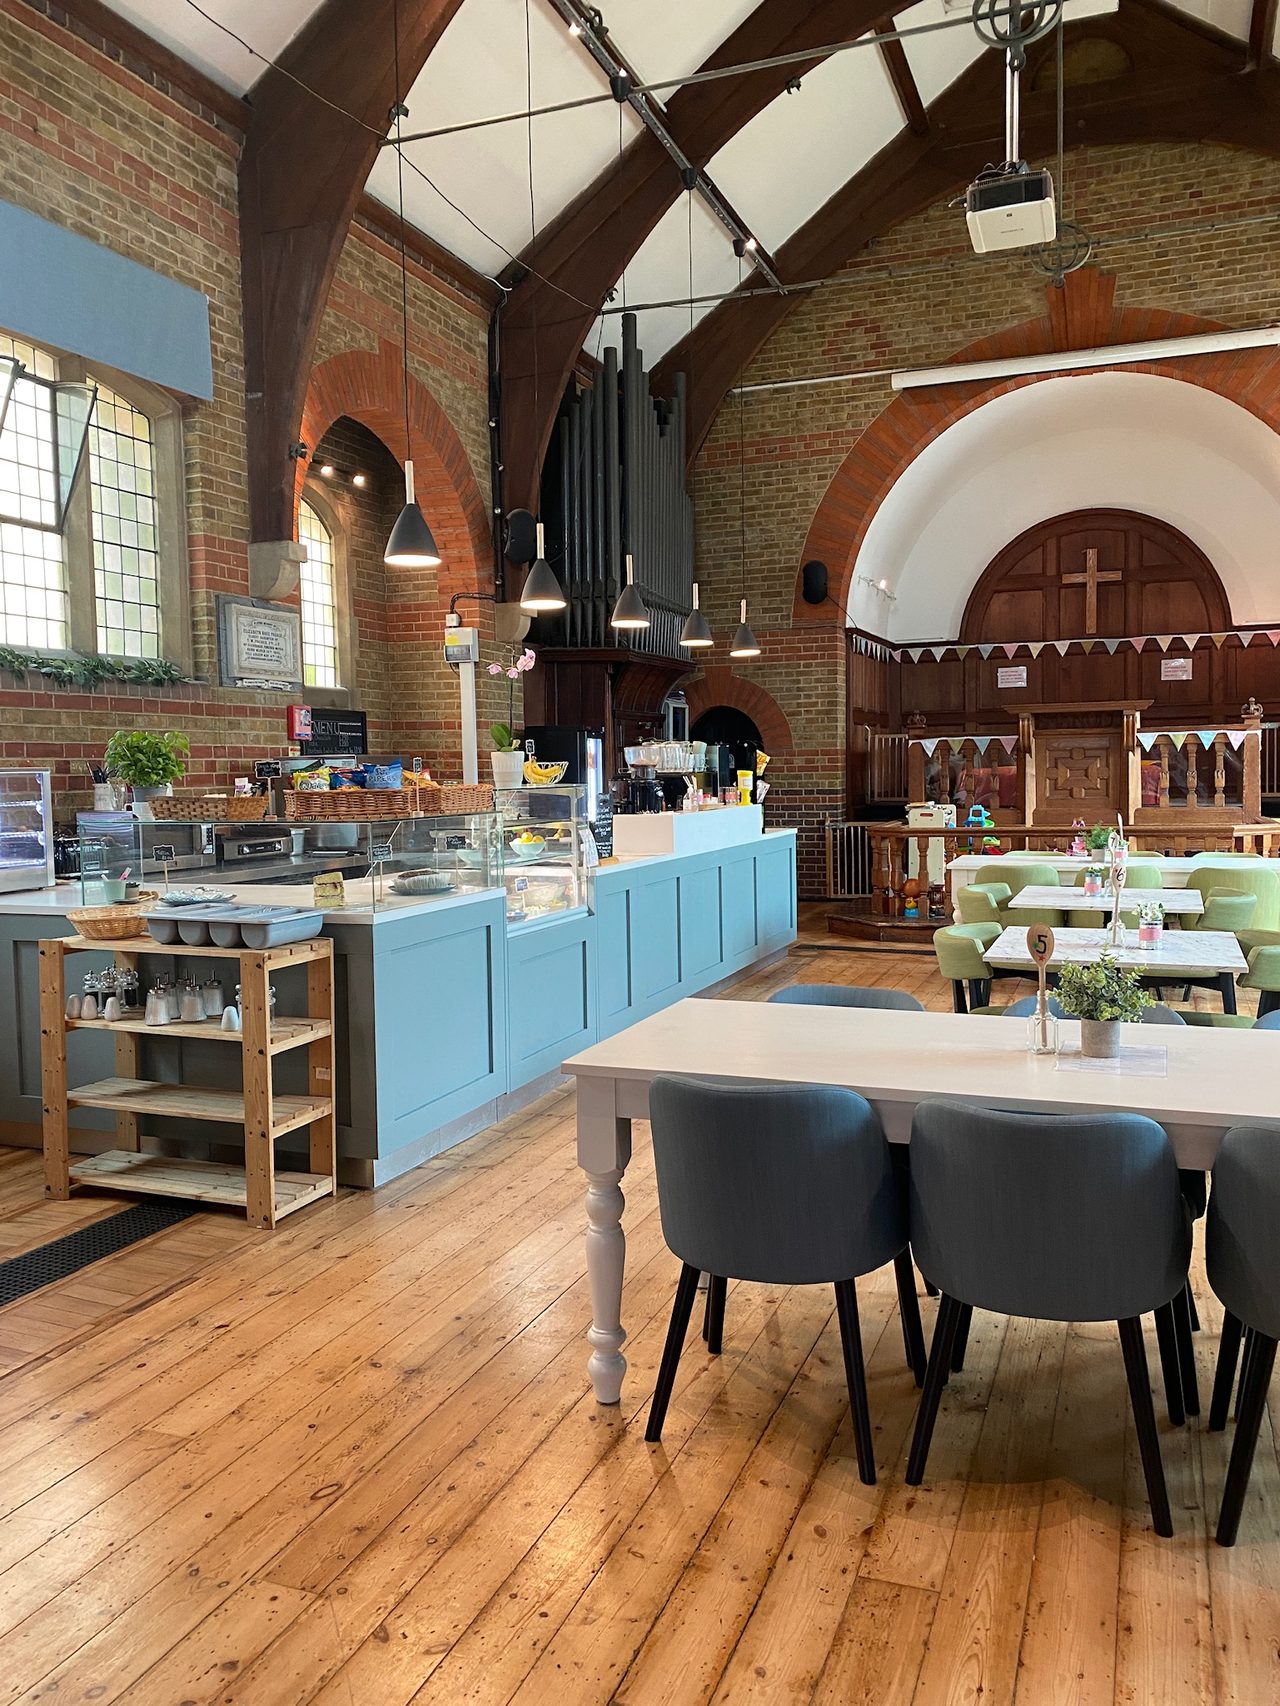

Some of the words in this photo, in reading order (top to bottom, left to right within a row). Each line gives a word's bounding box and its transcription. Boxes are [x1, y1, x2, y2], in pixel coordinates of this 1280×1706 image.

[312, 720, 340, 735] MENU
[1116, 867, 1123, 881] 6
[1036, 934, 1047, 954] 5
